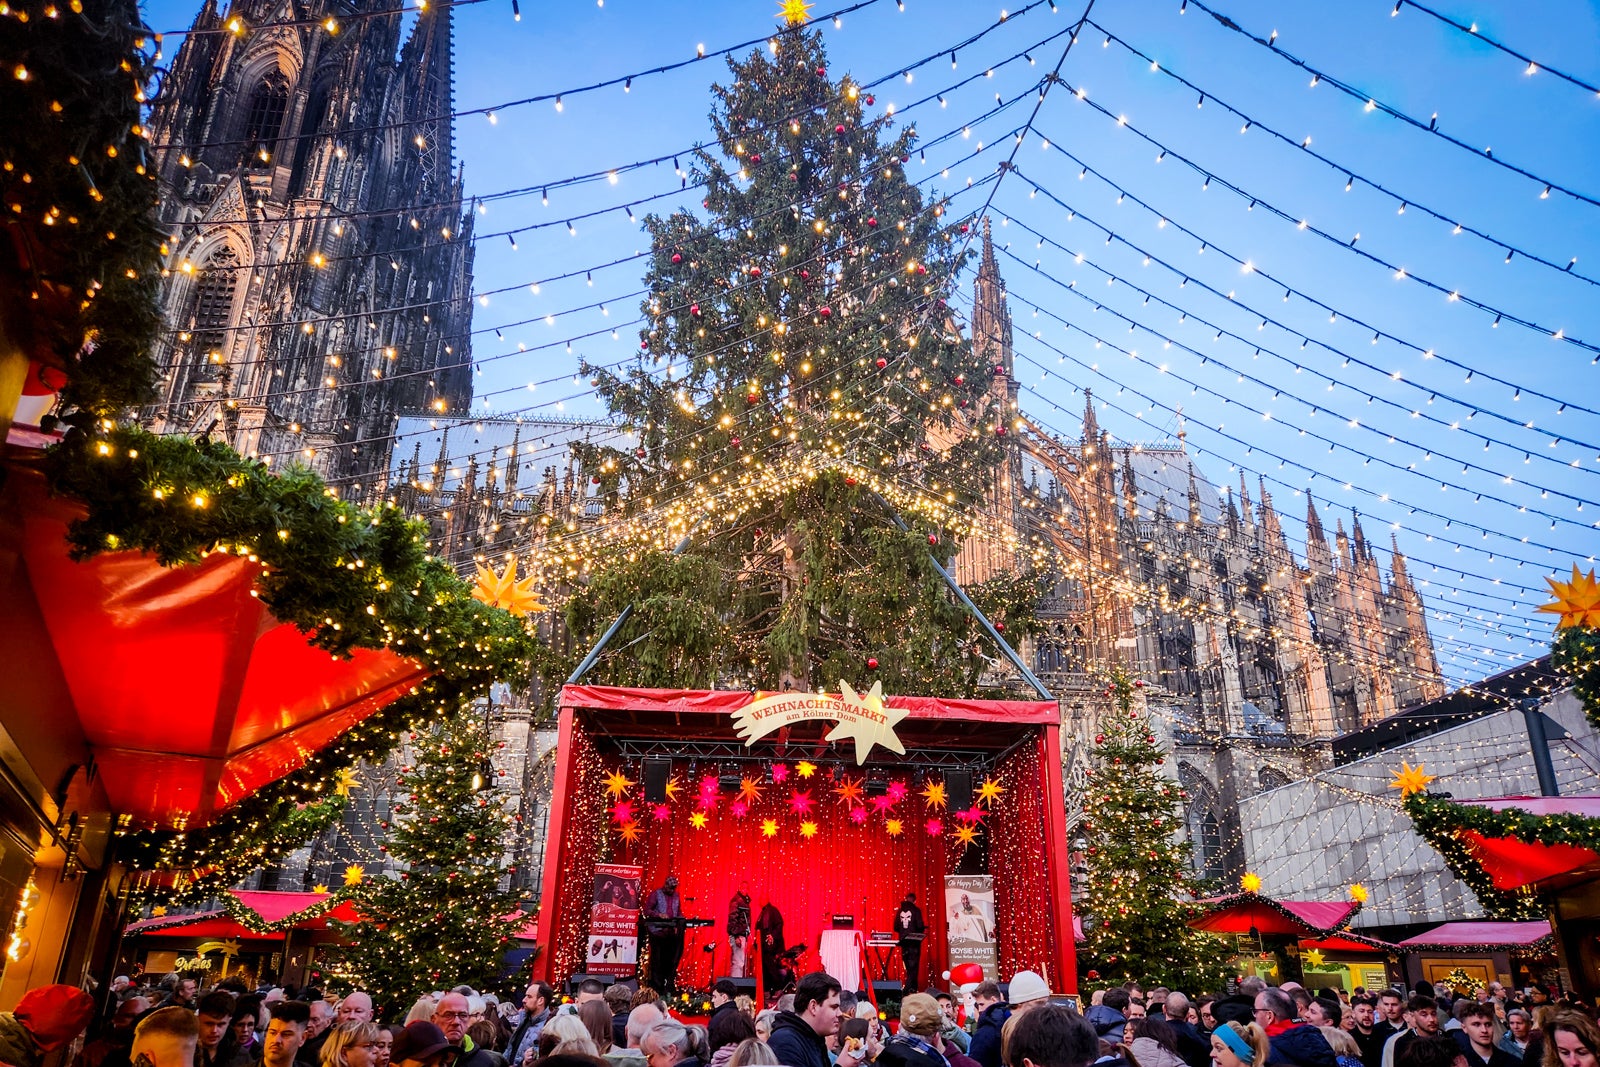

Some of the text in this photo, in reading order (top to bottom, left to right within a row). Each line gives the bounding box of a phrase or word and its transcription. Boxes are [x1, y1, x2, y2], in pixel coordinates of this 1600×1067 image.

[751, 699, 888, 725] WEIHNACHTSMARKT
[786, 709, 857, 723] am Kölner Dom
[957, 879, 971, 889] Happy
[973, 879, 983, 888] Day
[593, 921, 636, 930] BOYSIE WHITE
[950, 947, 995, 955] BOYSIE WHITE
